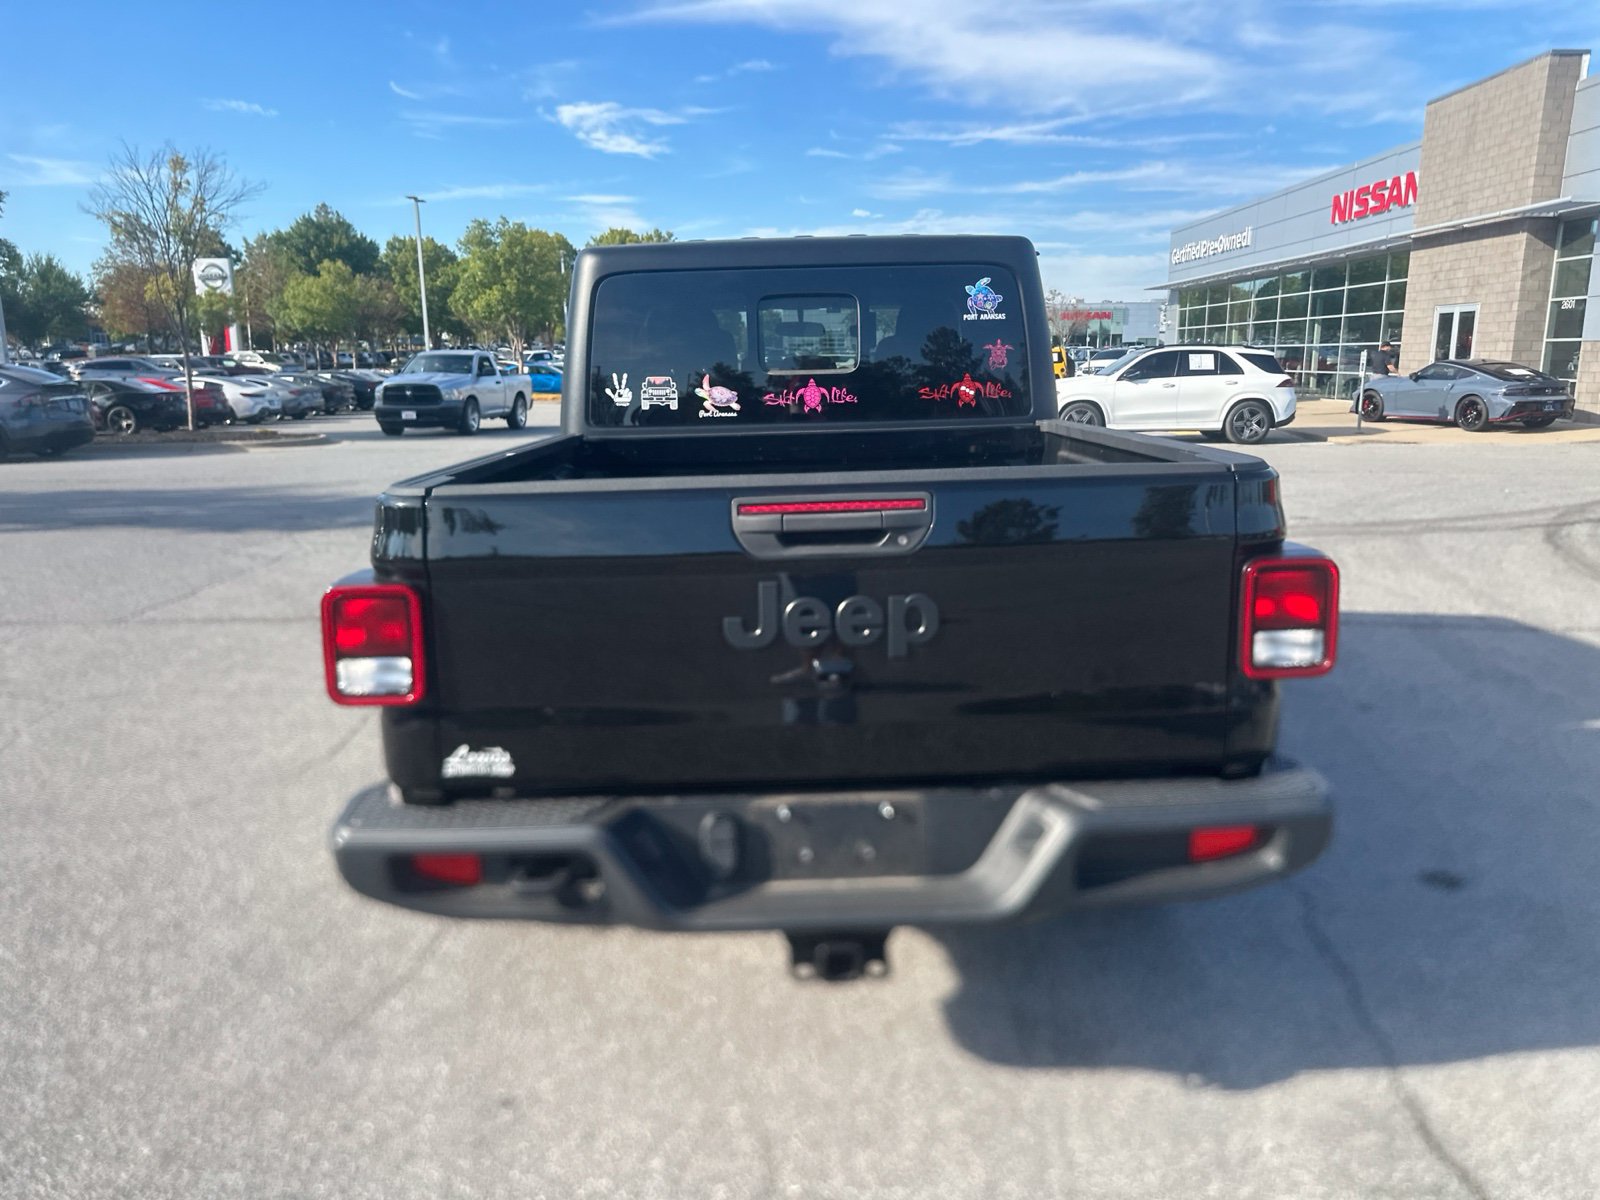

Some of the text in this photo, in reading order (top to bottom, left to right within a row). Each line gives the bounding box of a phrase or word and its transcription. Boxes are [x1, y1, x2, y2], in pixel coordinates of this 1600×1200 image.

[1331, 171, 1418, 224] NISSAN
[1171, 240, 1201, 264] Certified
[722, 580, 940, 657] Jeep
